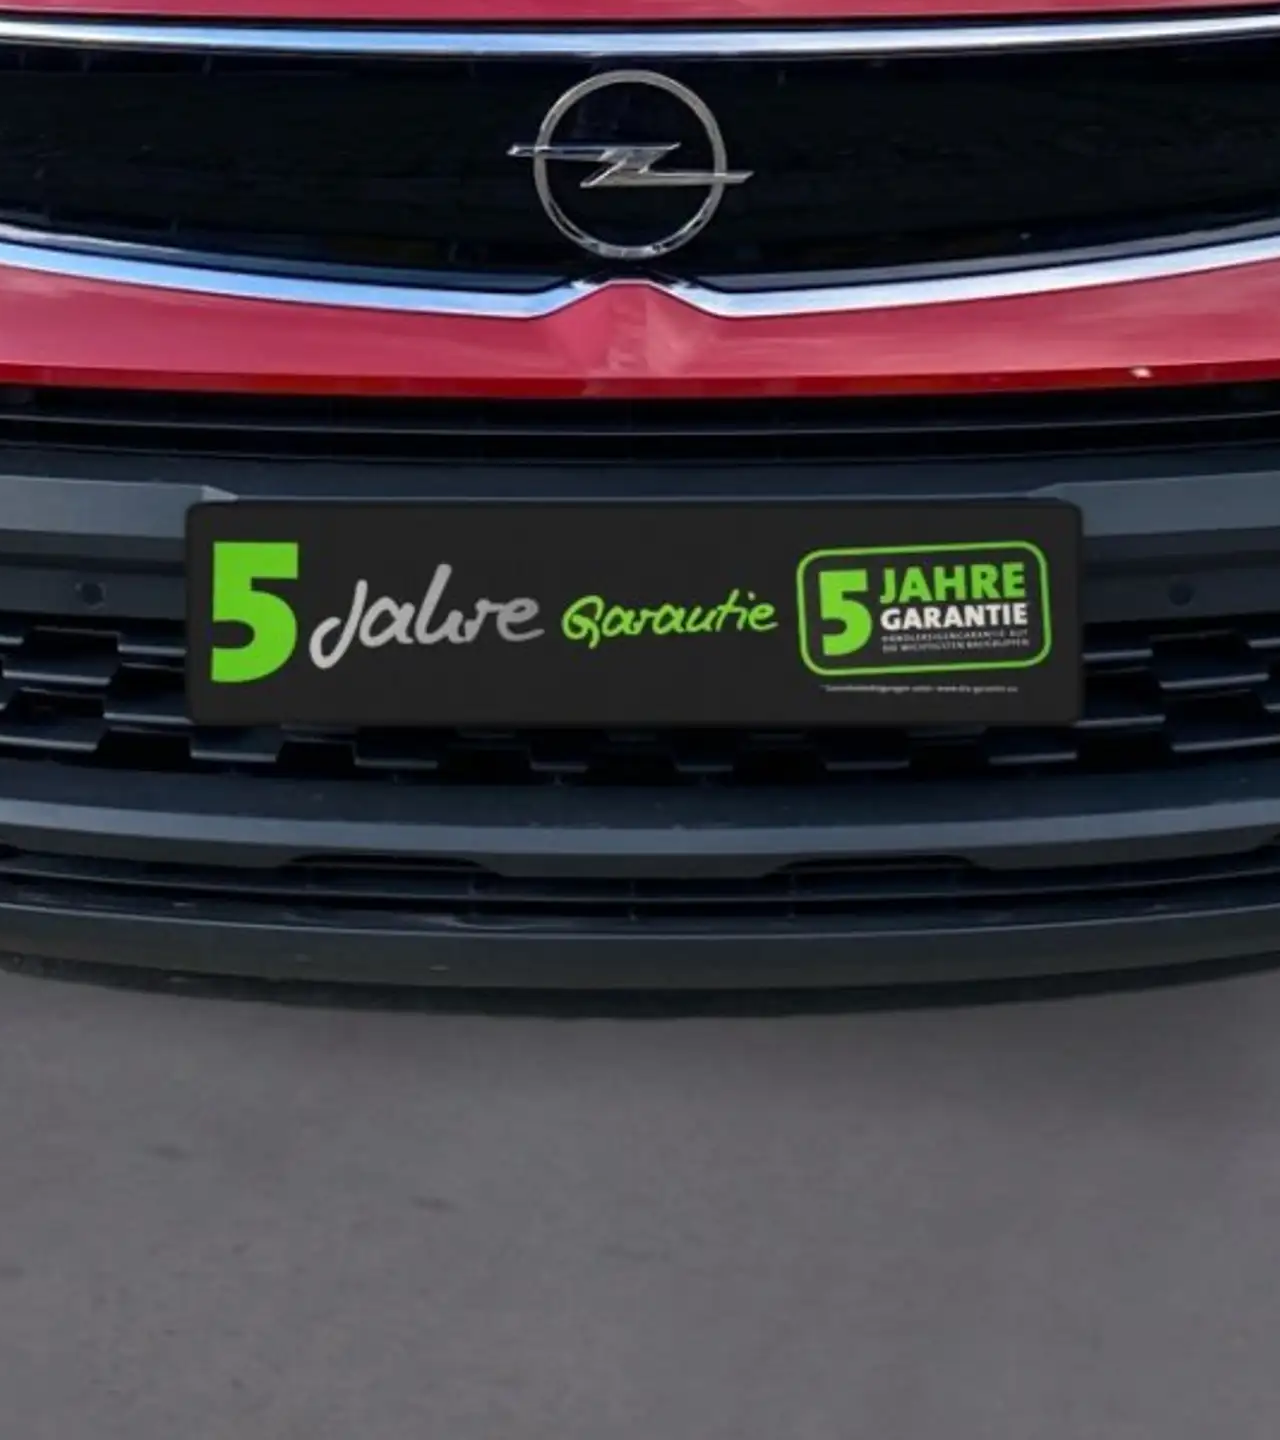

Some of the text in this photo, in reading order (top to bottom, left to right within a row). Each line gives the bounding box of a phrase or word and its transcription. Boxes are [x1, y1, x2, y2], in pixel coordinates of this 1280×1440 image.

[211, 541, 298, 682] 5
[309, 563, 545, 669] Jahre
[819, 568, 873, 656] 5
[879, 561, 1026, 604] JAHRE
[879, 602, 1029, 631] GARANTIE
